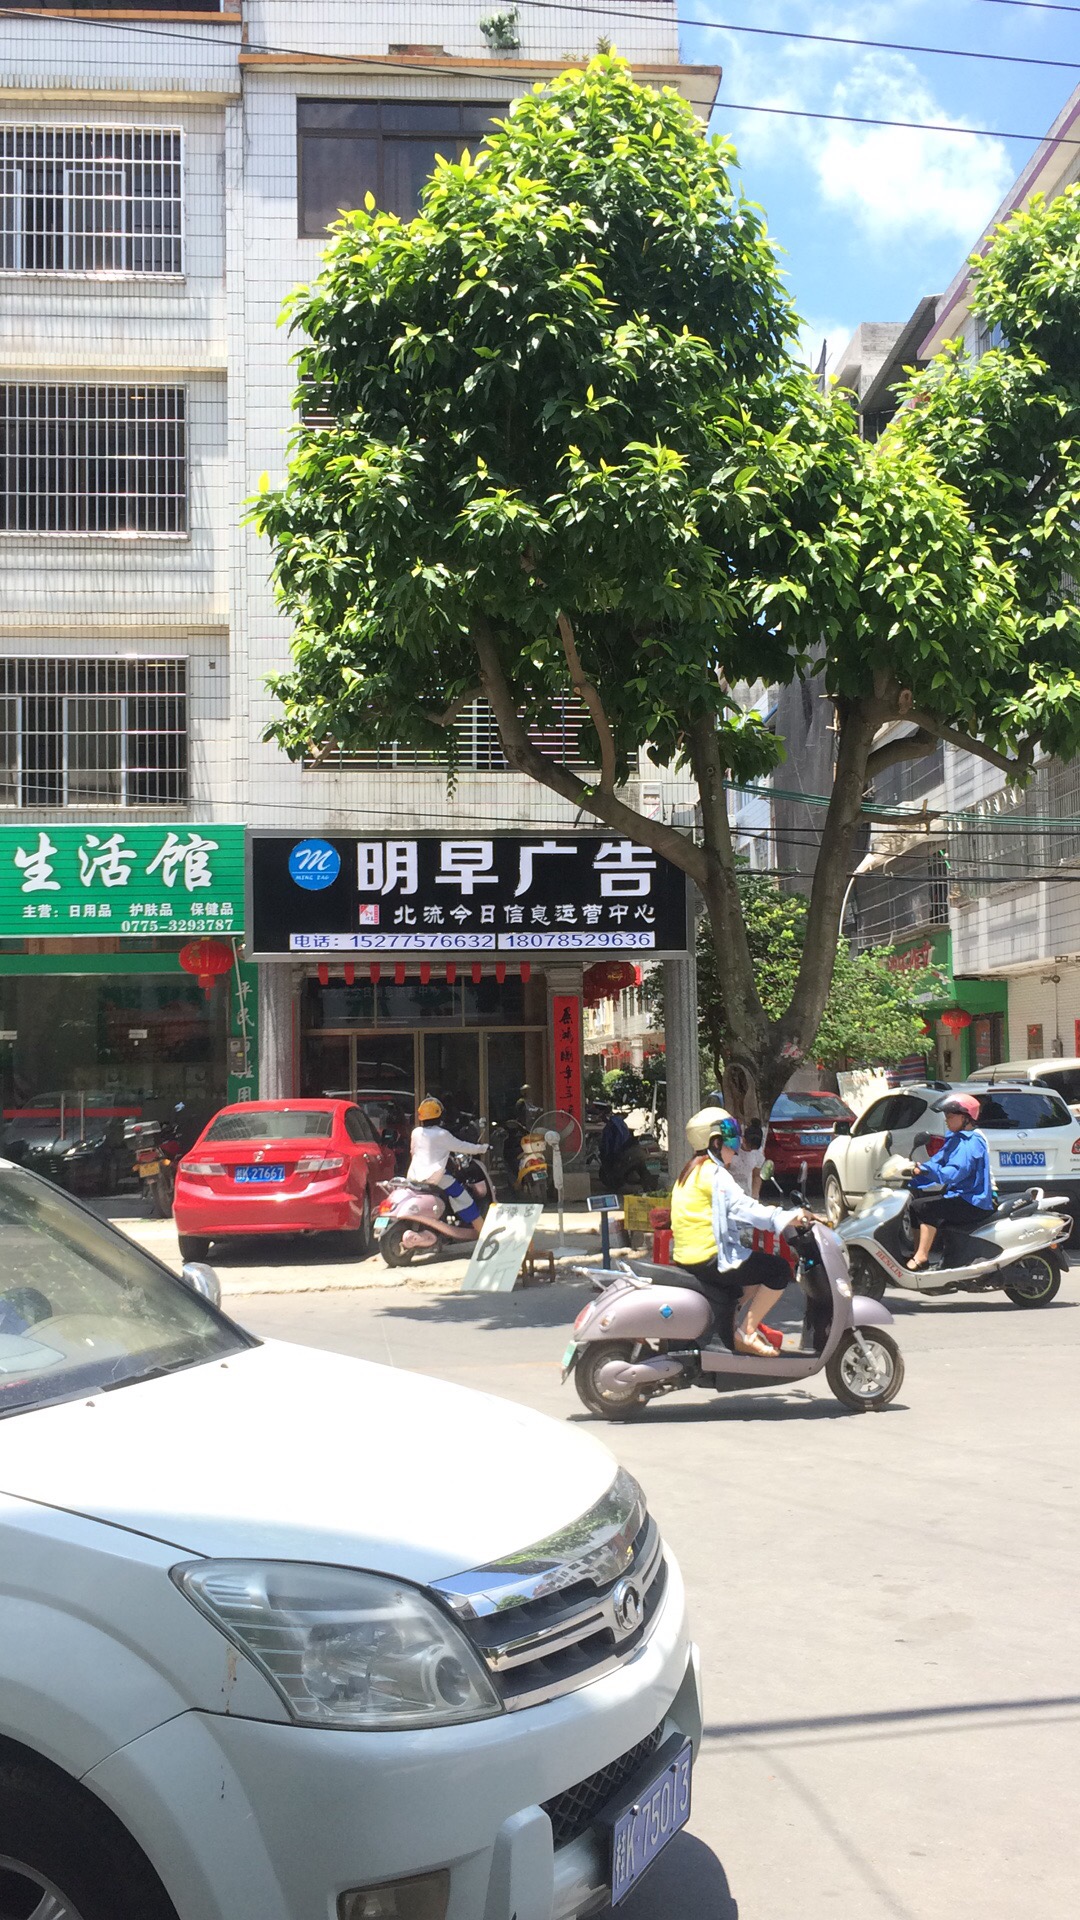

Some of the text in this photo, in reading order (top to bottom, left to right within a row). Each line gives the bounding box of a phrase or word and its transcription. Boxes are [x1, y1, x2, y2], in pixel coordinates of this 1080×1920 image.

[14, 832, 219, 892] 生活馆
[357, 840, 657, 897] 明早广告
[129, 903, 173, 917] 护肤品
[190, 902, 234, 916] 保健品
[394, 903, 656, 925] 北流今日信息运营中心
[121, 919, 234, 932] 0775-3293787
[506, 933, 650, 947] 18078529636
